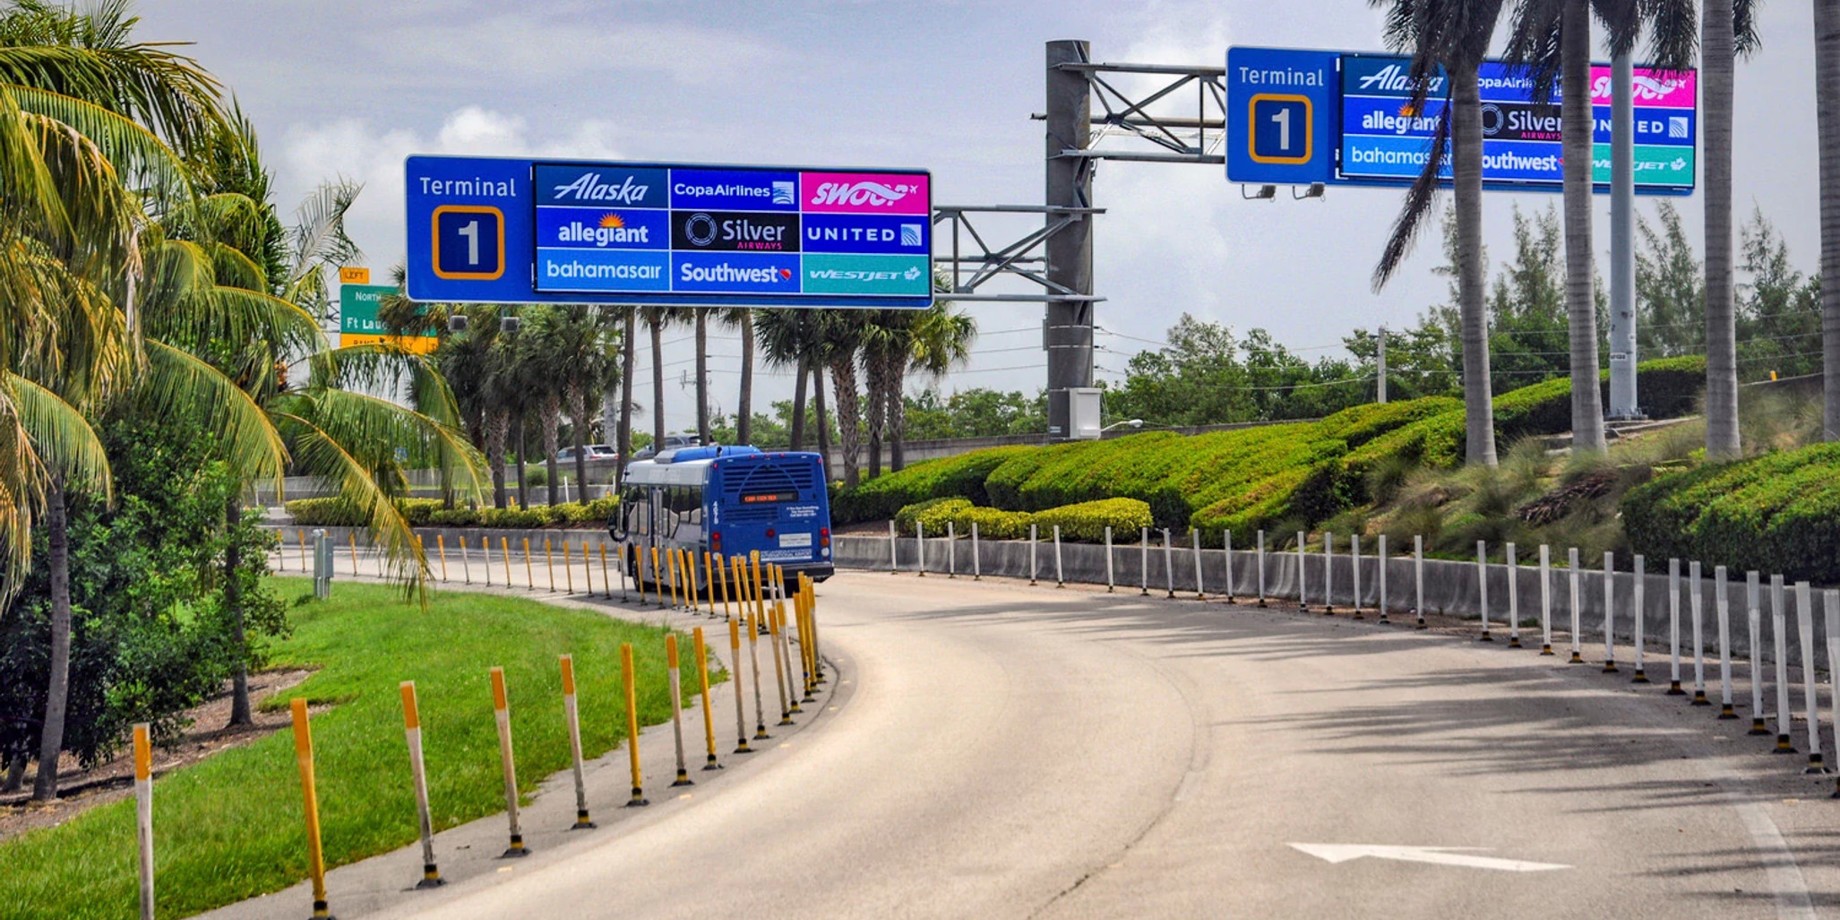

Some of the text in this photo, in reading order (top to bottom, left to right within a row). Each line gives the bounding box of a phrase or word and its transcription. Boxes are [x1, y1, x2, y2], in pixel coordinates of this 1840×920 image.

[1239, 67, 1323, 86] Terminal
[1271, 108, 1290, 150] 1
[1482, 151, 1557, 171] outhwest
[419, 177, 516, 197] Terminal
[553, 172, 648, 204] Alaska
[674, 183, 770, 198] CopaAirlines
[558, 222, 649, 247] allegiant
[722, 219, 785, 241] Silver
[807, 227, 895, 242] UNITED
[458, 220, 479, 265] 1
[737, 241, 782, 250] AIRWAYS
[547, 260, 662, 279] bahamasair
[681, 263, 778, 282] Southwest
[809, 269, 903, 281] WESTJET
[346, 317, 358, 329] Ft
